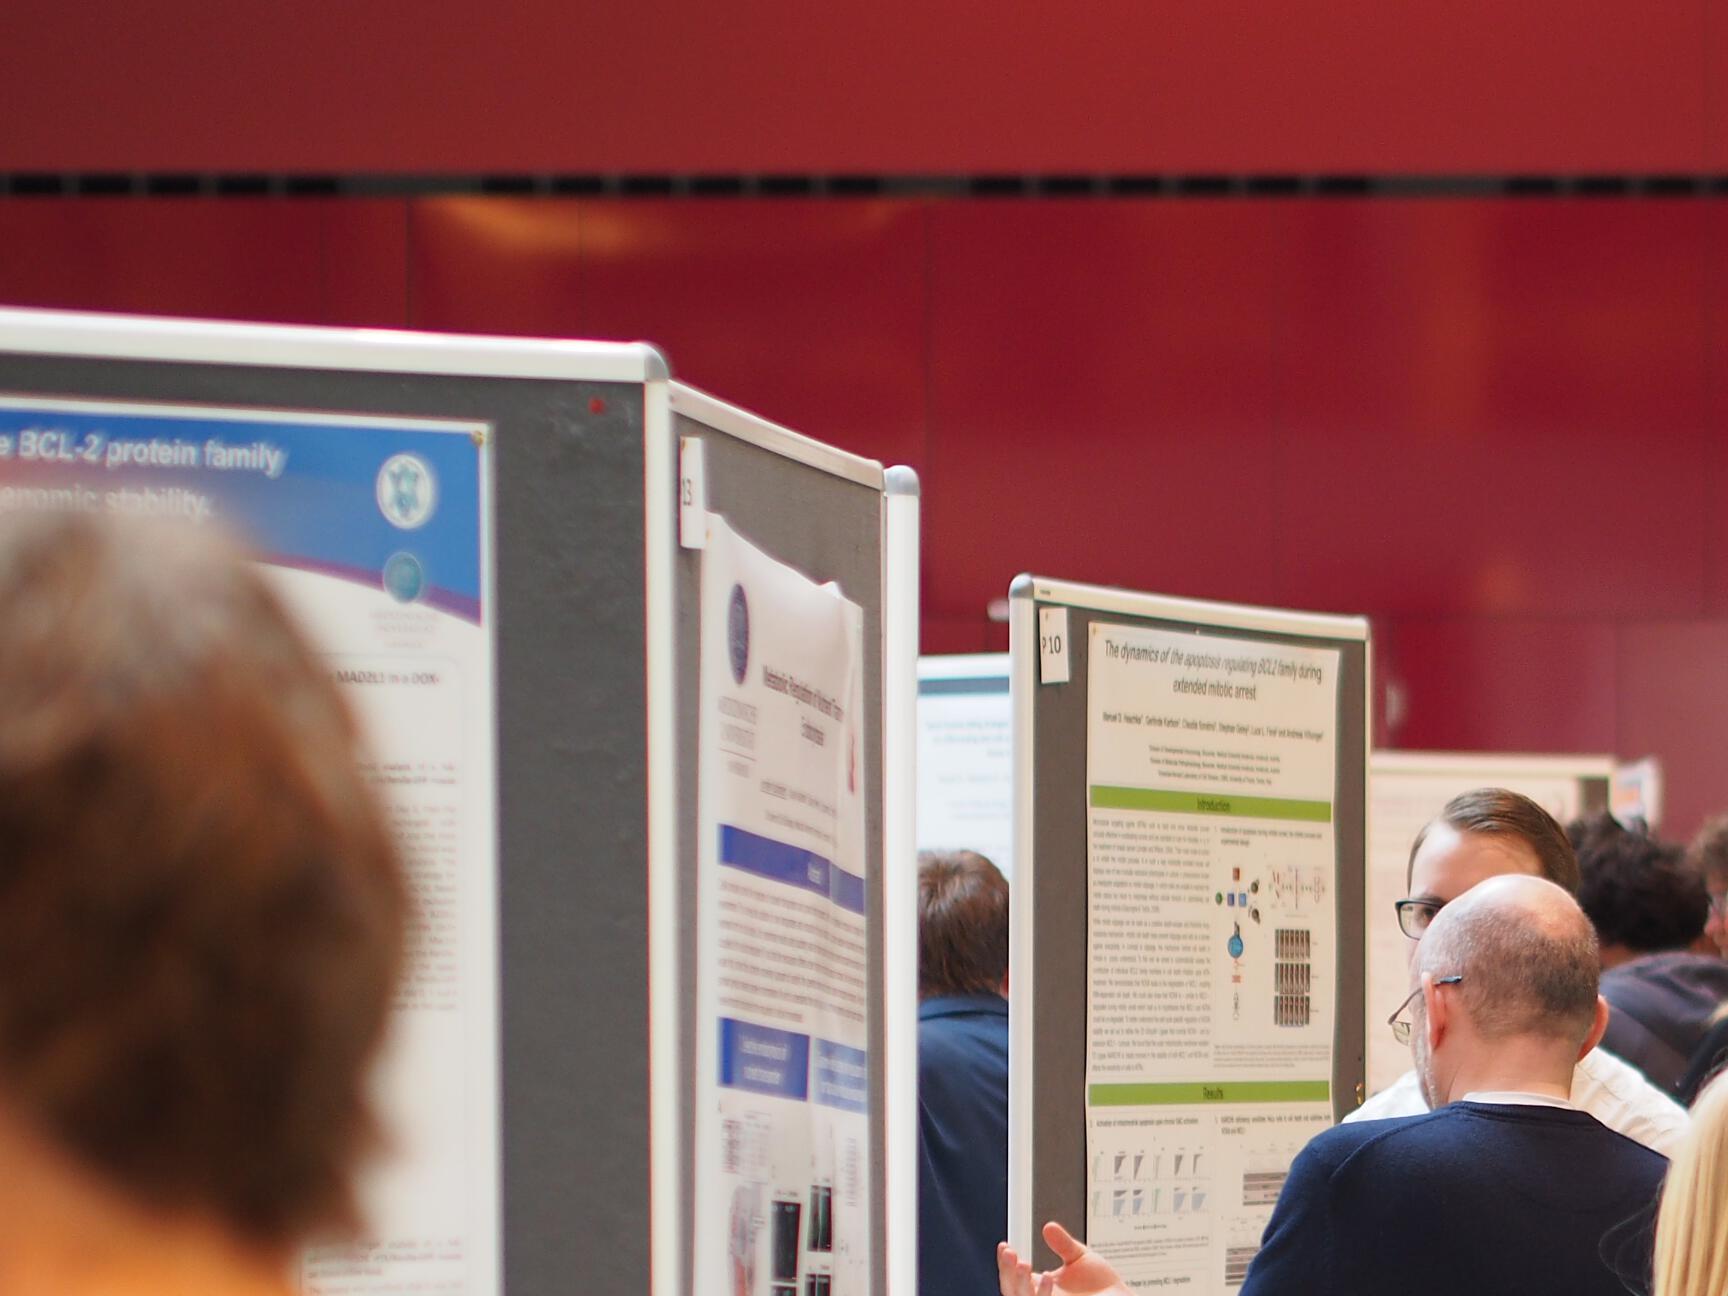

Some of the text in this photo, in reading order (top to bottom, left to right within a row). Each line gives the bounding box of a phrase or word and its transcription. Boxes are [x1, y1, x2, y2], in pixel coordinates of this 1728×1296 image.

[18, 430, 99, 461] BCL-2
[106, 440, 197, 467] protein
[205, 440, 282, 479] family
[1049, 635, 1062, 654] 10
[1105, 640, 1119, 659] The
[1120, 643, 1159, 664] dynamics
[1160, 647, 1172, 663] of
[1171, 647, 1184, 666] the
[1277, 660, 1297, 683] family
[1299, 664, 1322, 685] during
[1173, 677, 1257, 701] extended mitotic arrest
[1197, 795, 1231, 812] Introduction
